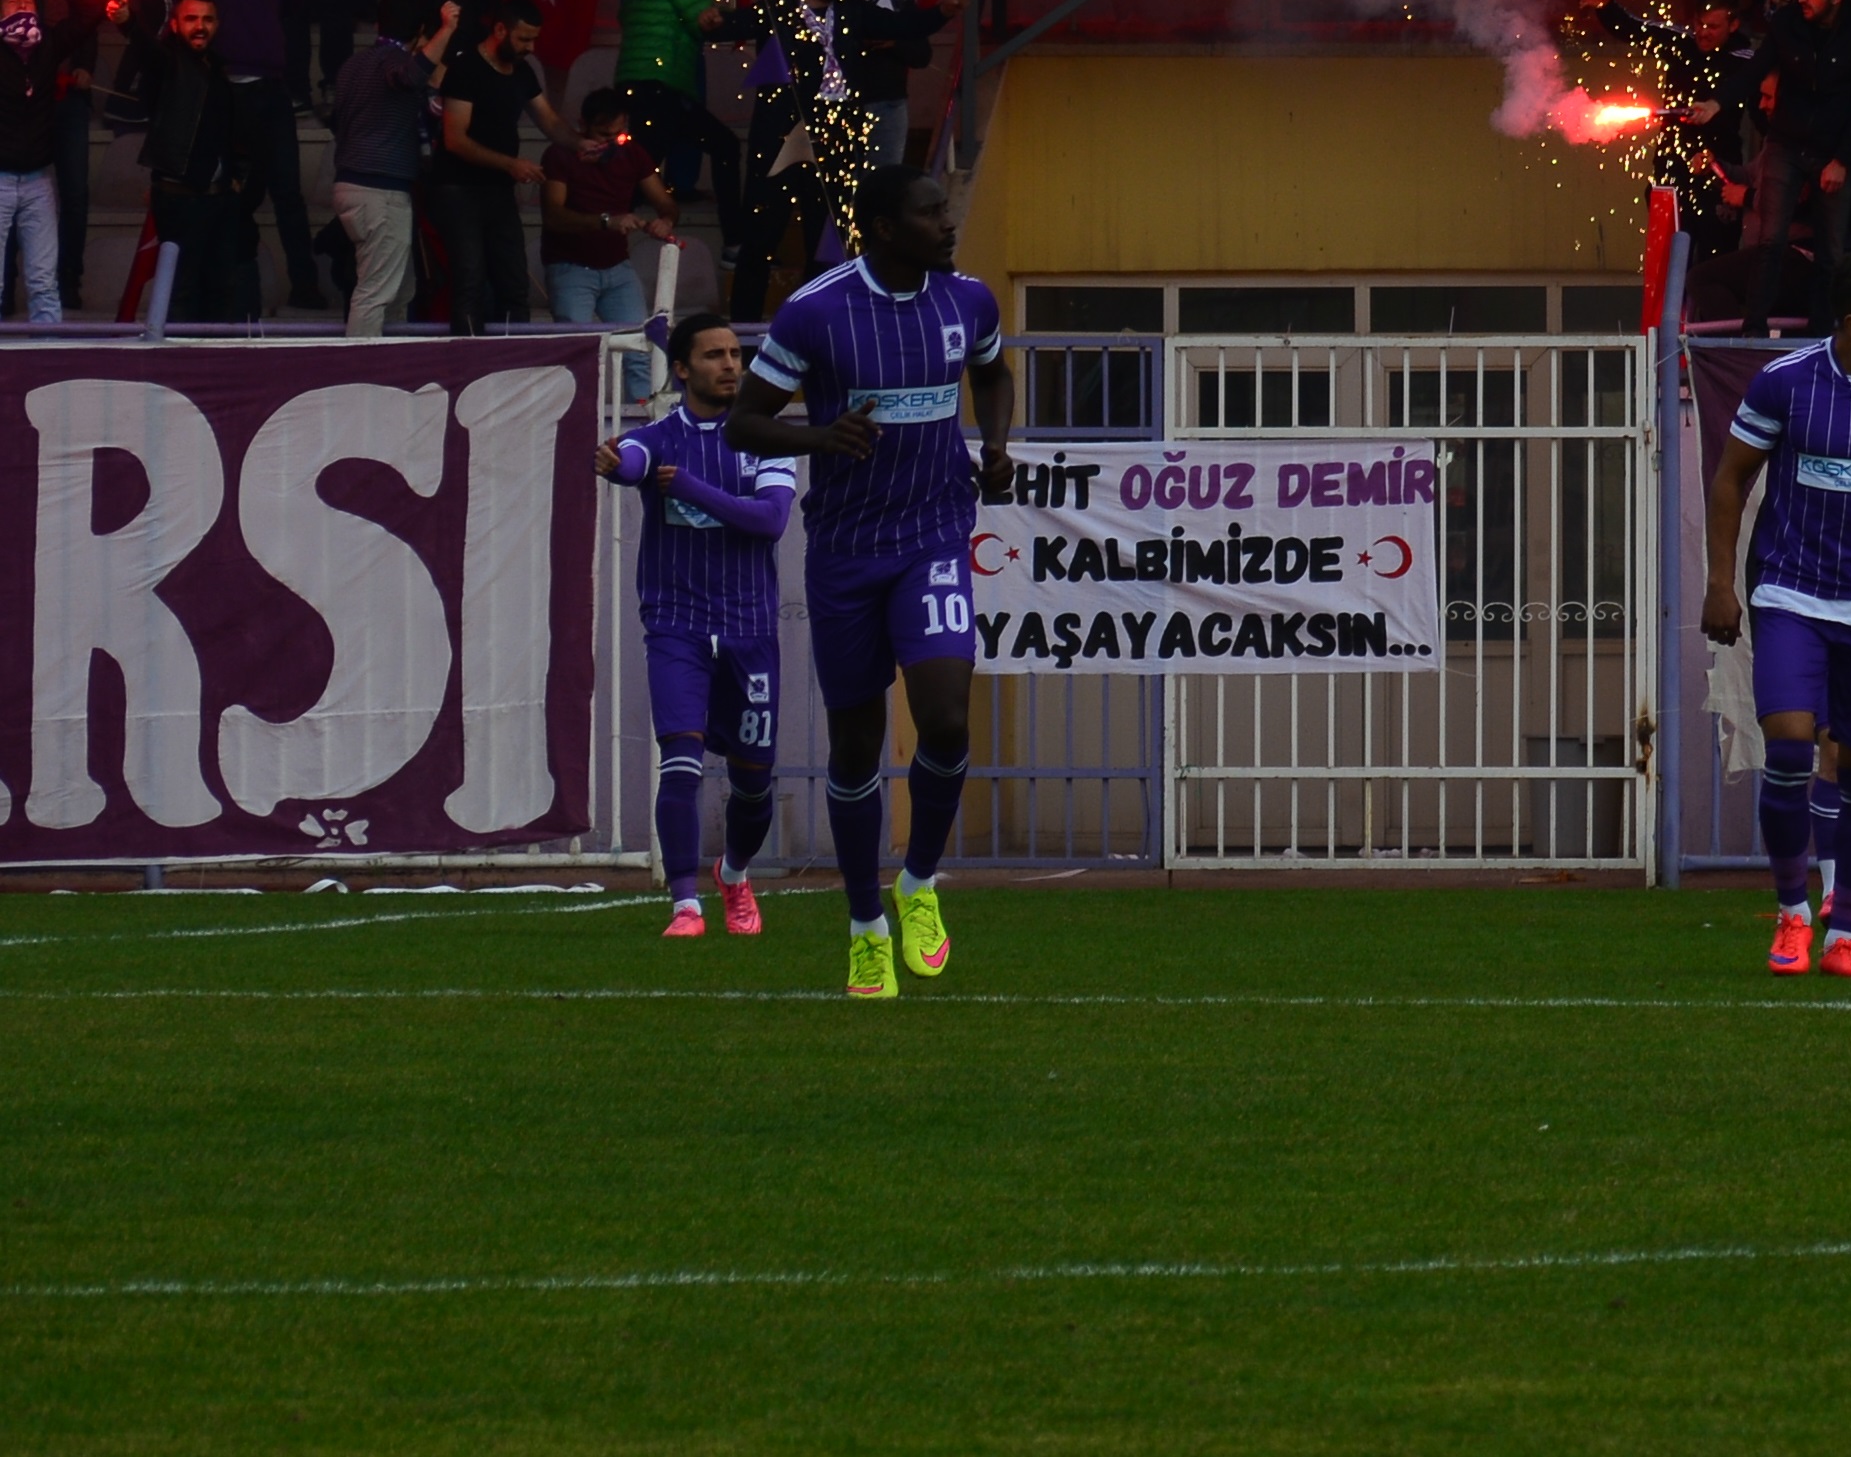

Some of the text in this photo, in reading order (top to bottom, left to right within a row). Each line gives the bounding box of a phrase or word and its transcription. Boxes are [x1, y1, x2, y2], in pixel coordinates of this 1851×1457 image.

[970, 446, 1435, 510] HİT OĞUZ DEMİR
[1033, 523, 1344, 583] KALBİMİZDE
[921, 592, 969, 636] 10
[975, 611, 1432, 669] YAŞAYACAKSIN...
[738, 709, 772, 749] 81
